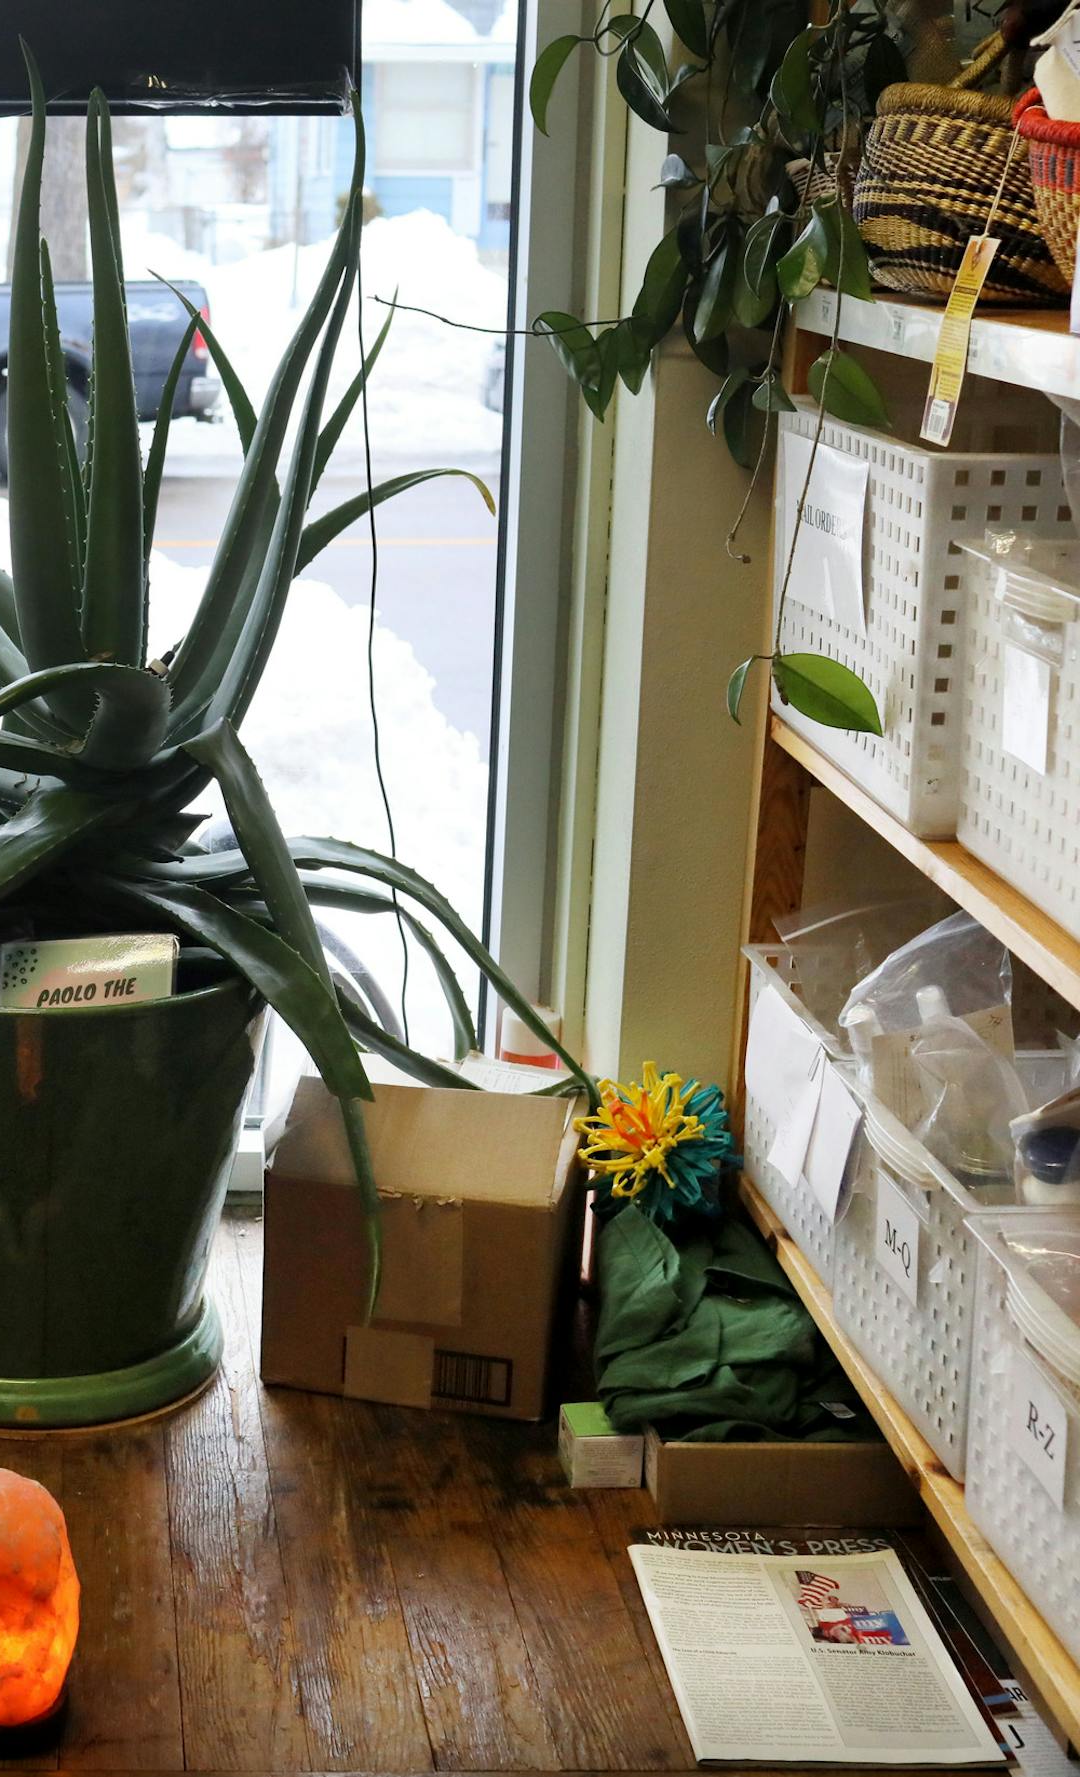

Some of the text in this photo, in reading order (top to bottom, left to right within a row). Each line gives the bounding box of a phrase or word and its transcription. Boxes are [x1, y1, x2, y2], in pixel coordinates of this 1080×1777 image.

[37, 977, 137, 1008] PAOLO THE
[885, 1219, 912, 1278] M-Q
[1027, 1400, 1056, 1460] R-Z
[647, 1531, 765, 1541] MINNESOTA
[807, 1538, 891, 1556] PRESS
